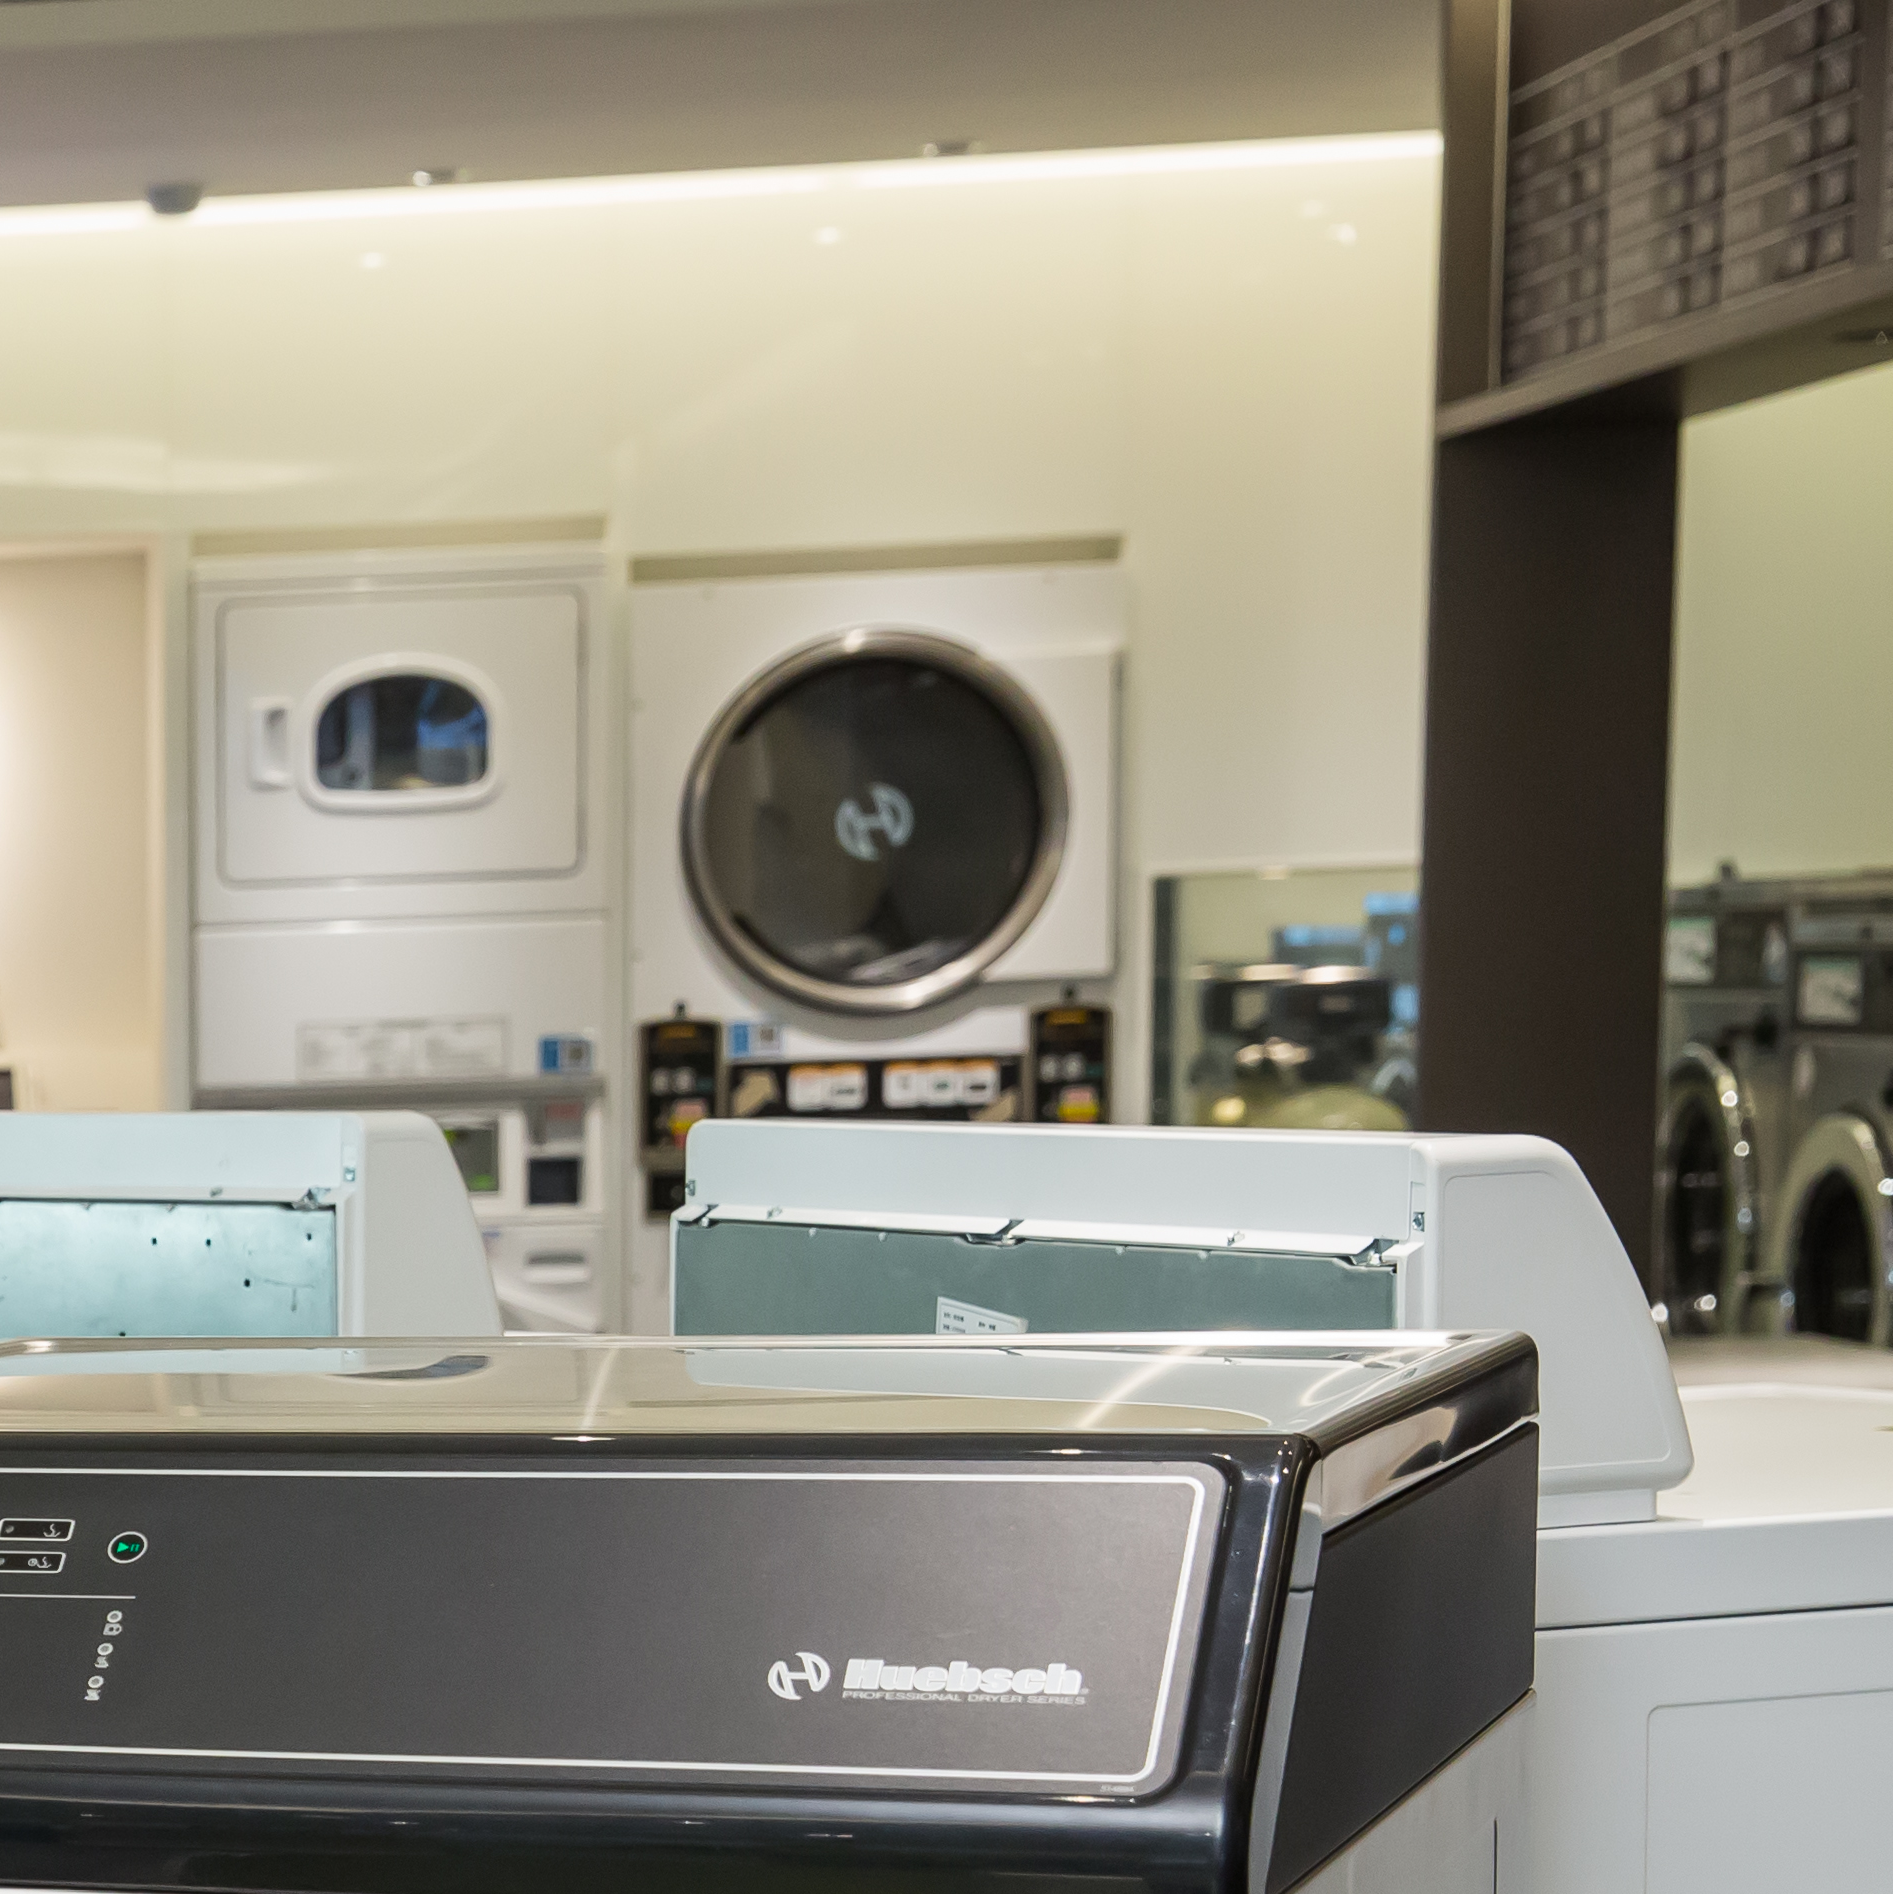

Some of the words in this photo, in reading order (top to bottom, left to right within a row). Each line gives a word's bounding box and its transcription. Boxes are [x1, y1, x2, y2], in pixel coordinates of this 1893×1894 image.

[842, 1658, 1083, 1696] Huebsch
[842, 1690, 962, 1702] PROFESSIONAL
[967, 1693, 1022, 1703] DRYER
[1026, 1695, 1085, 1705] SERIES
